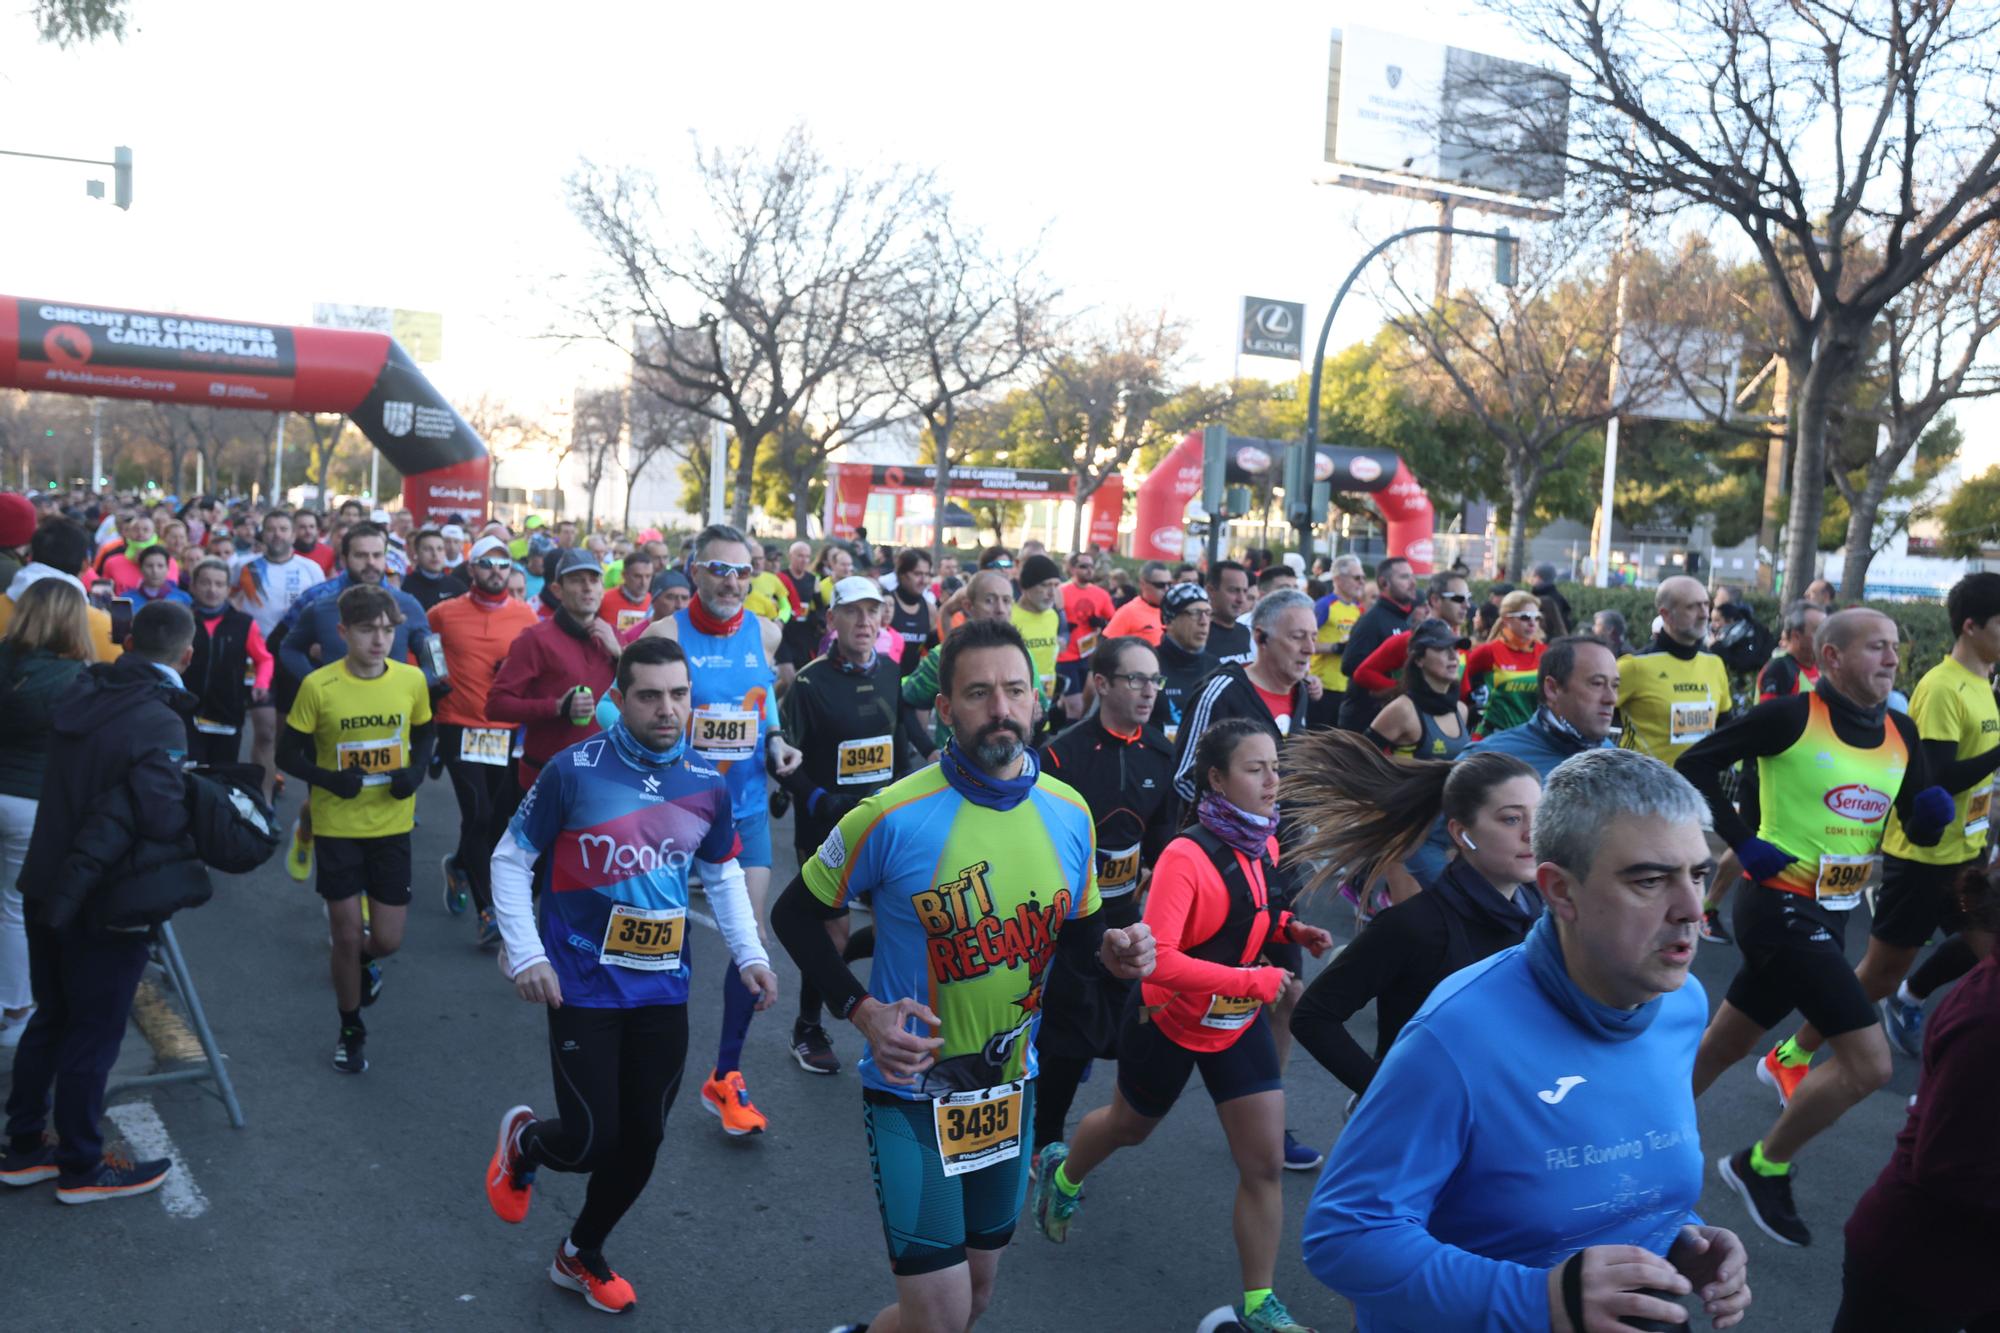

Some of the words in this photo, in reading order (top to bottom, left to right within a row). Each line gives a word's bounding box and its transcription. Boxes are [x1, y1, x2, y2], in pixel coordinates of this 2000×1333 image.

[38, 305, 126, 328] CIRCUIT
[129, 313, 160, 332] DE
[162, 317, 275, 343] CARRERES
[703, 719, 747, 741] 3481
[348, 747, 391, 769] 3476
[847, 746, 884, 767] 3942
[1833, 792, 1888, 814] Serrano
[1101, 856, 1133, 879] 874
[911, 860, 994, 937] BTT
[618, 917, 673, 947] 3575
[946, 1098, 1009, 1142] 3435
[1546, 1145, 1580, 1170] FAE
[1583, 1137, 1643, 1166] Running
